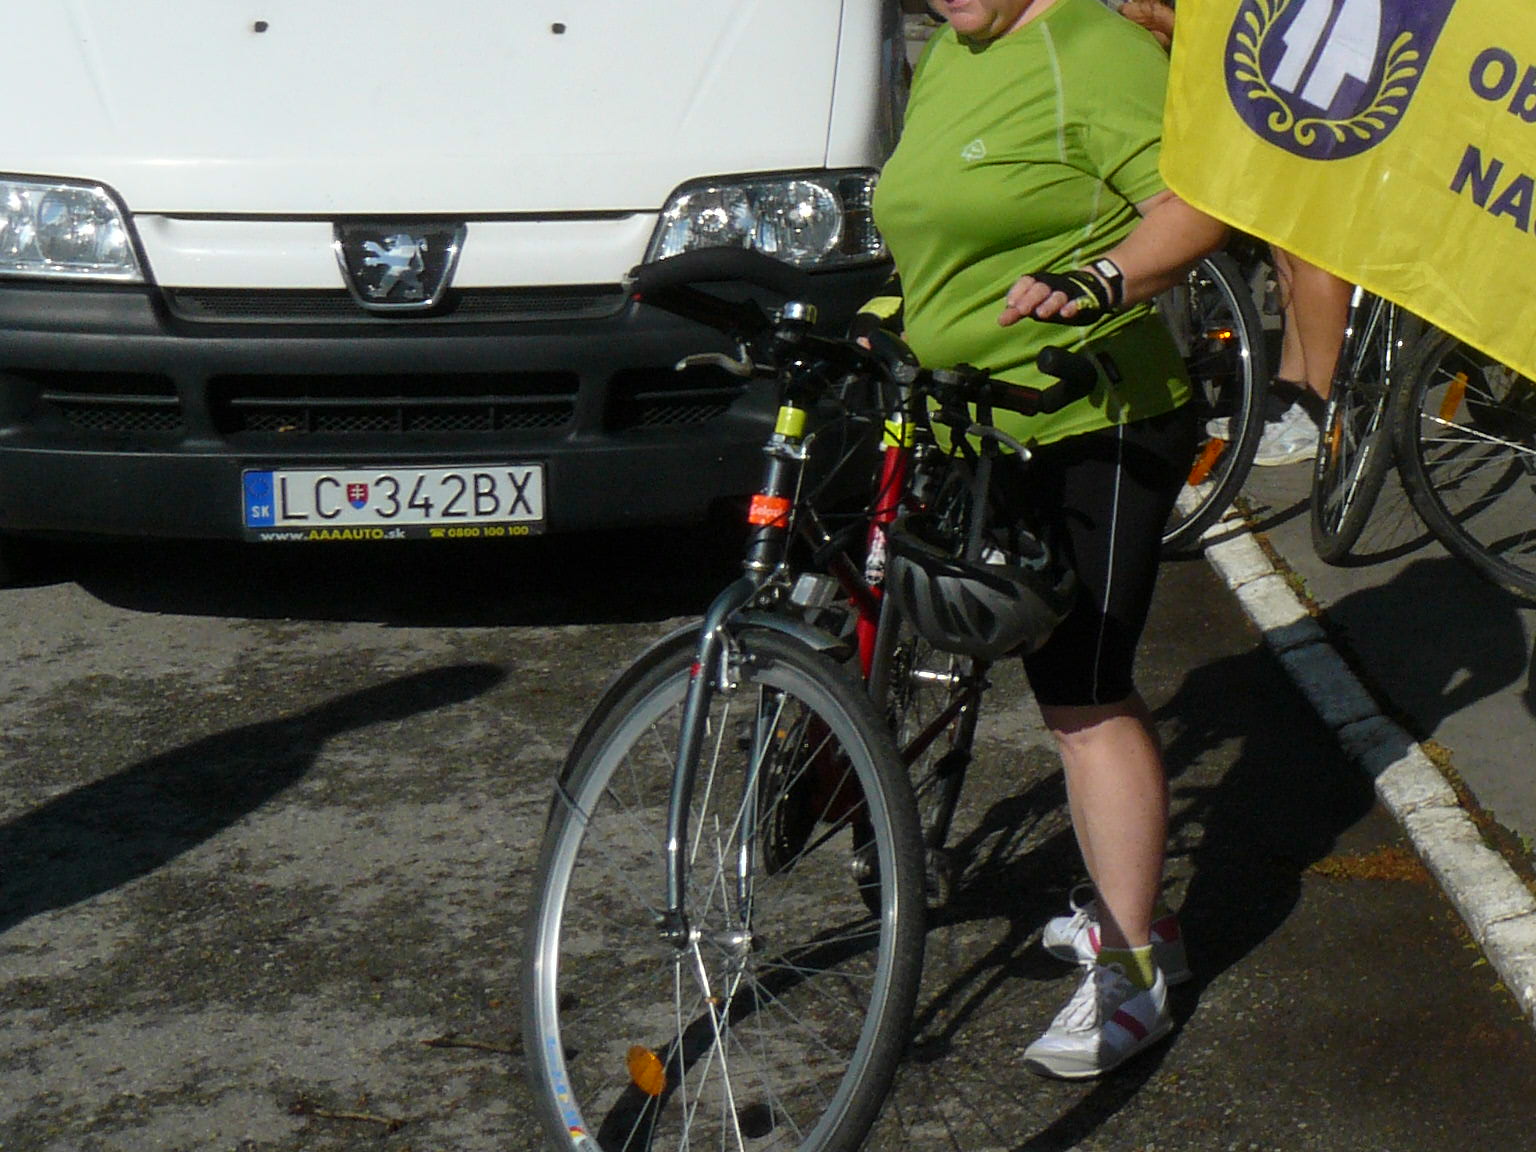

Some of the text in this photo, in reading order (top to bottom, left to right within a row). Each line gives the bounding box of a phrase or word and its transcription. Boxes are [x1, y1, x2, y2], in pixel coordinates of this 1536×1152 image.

[373, 471, 534, 519] 342BX
[250, 505, 271, 519] SK
[259, 527, 406, 542] www.AAAAUTO.sk
